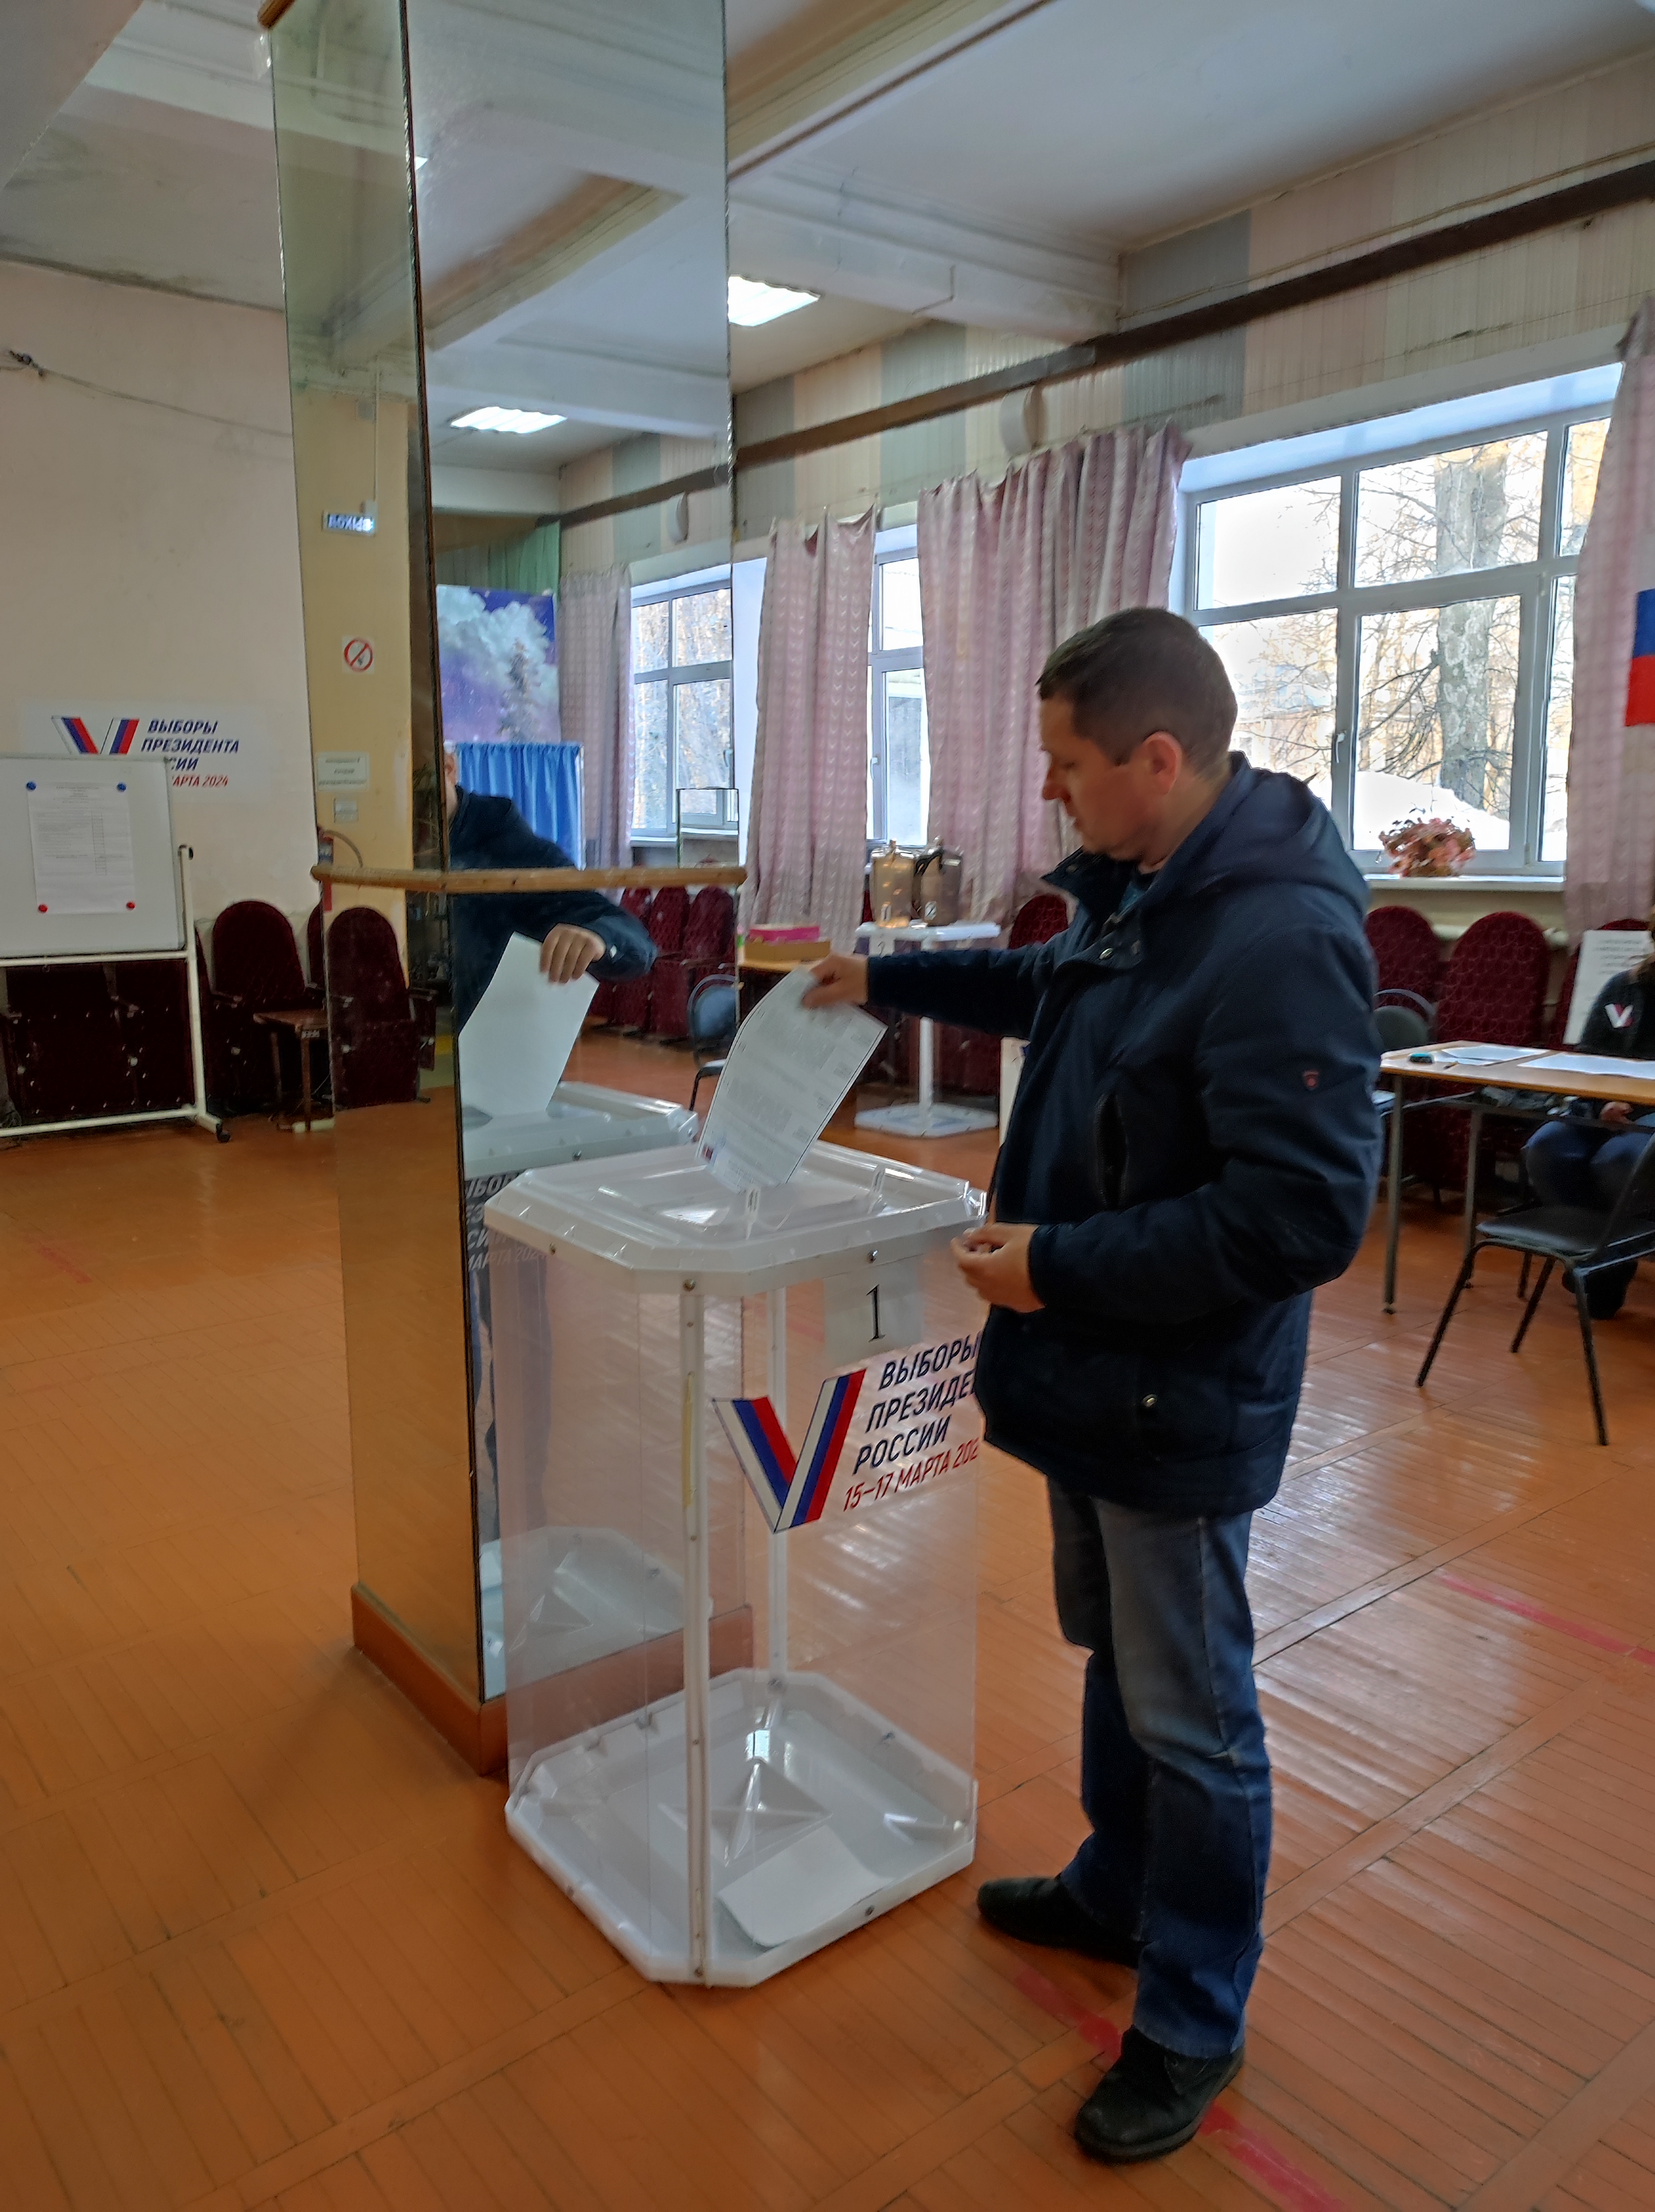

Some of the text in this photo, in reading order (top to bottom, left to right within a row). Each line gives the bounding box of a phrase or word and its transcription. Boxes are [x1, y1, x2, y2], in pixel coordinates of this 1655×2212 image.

[141, 738, 239, 755] ПРЕЗИДЕНТА
[148, 719, 218, 735] ВЫБОРЫ
[172, 775, 229, 787] АРТА 2024
[867, 1284, 886, 1343] 1
[878, 1331, 983, 1391] ВЫБОРЫ
[865, 1368, 977, 1434] ПРЕЗИДЕ
[852, 1413, 952, 1476] РОССИИ
[894, 1449, 952, 1494] МАРТА
